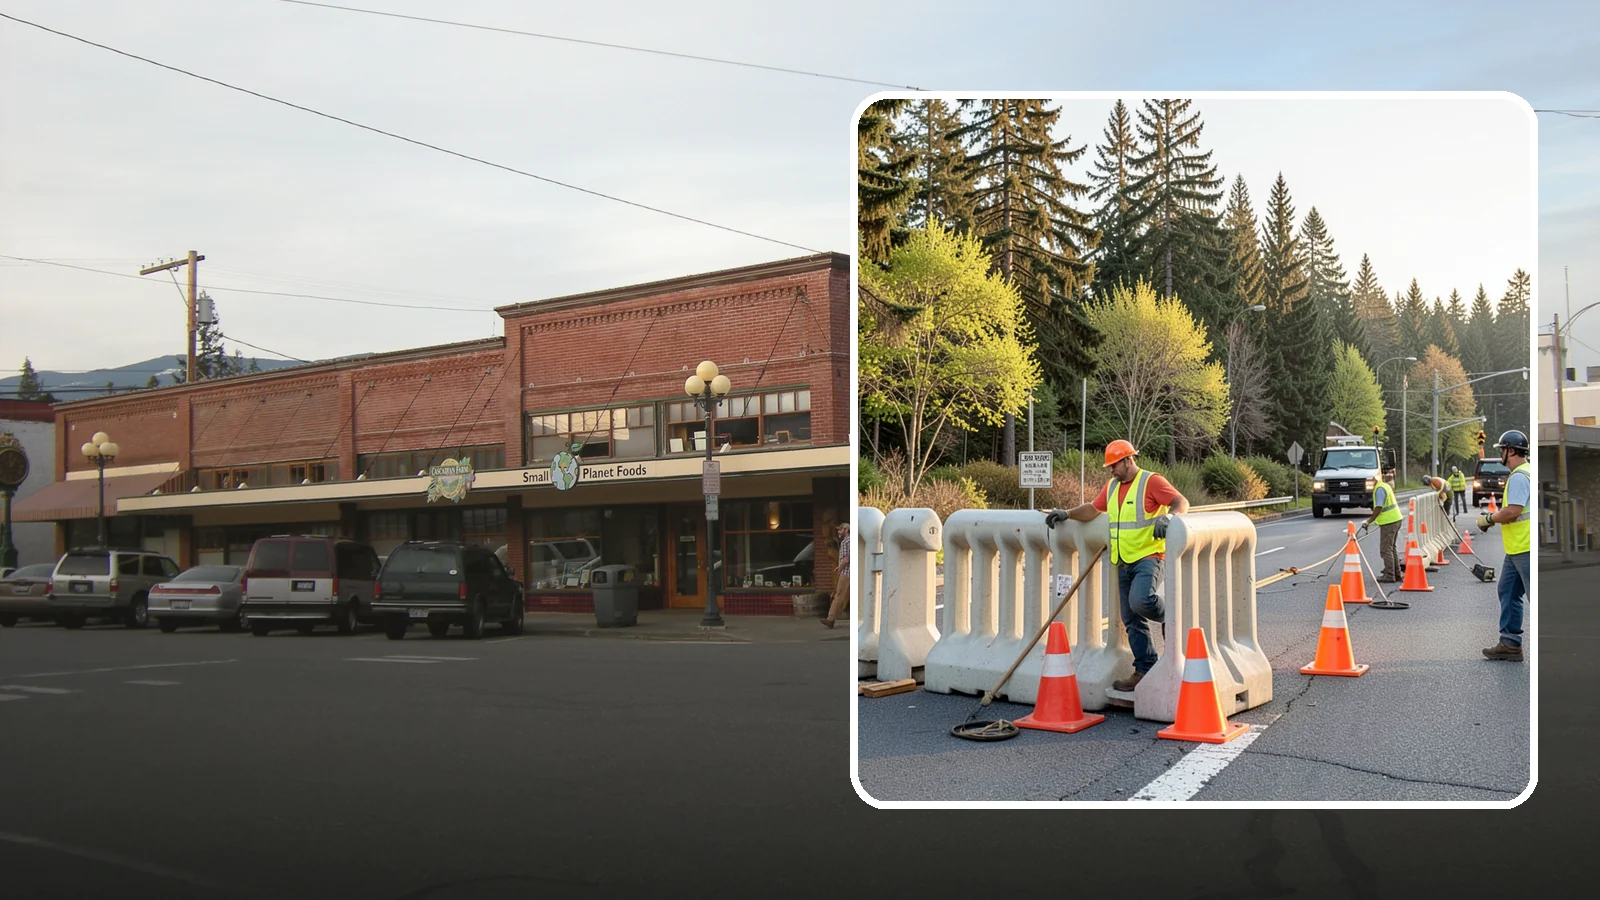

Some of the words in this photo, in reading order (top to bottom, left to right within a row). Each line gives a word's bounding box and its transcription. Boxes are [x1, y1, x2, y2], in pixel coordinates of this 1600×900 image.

[523, 471, 549, 482] Small
[582, 467, 614, 479] Planet
[617, 464, 647, 477] Foods
